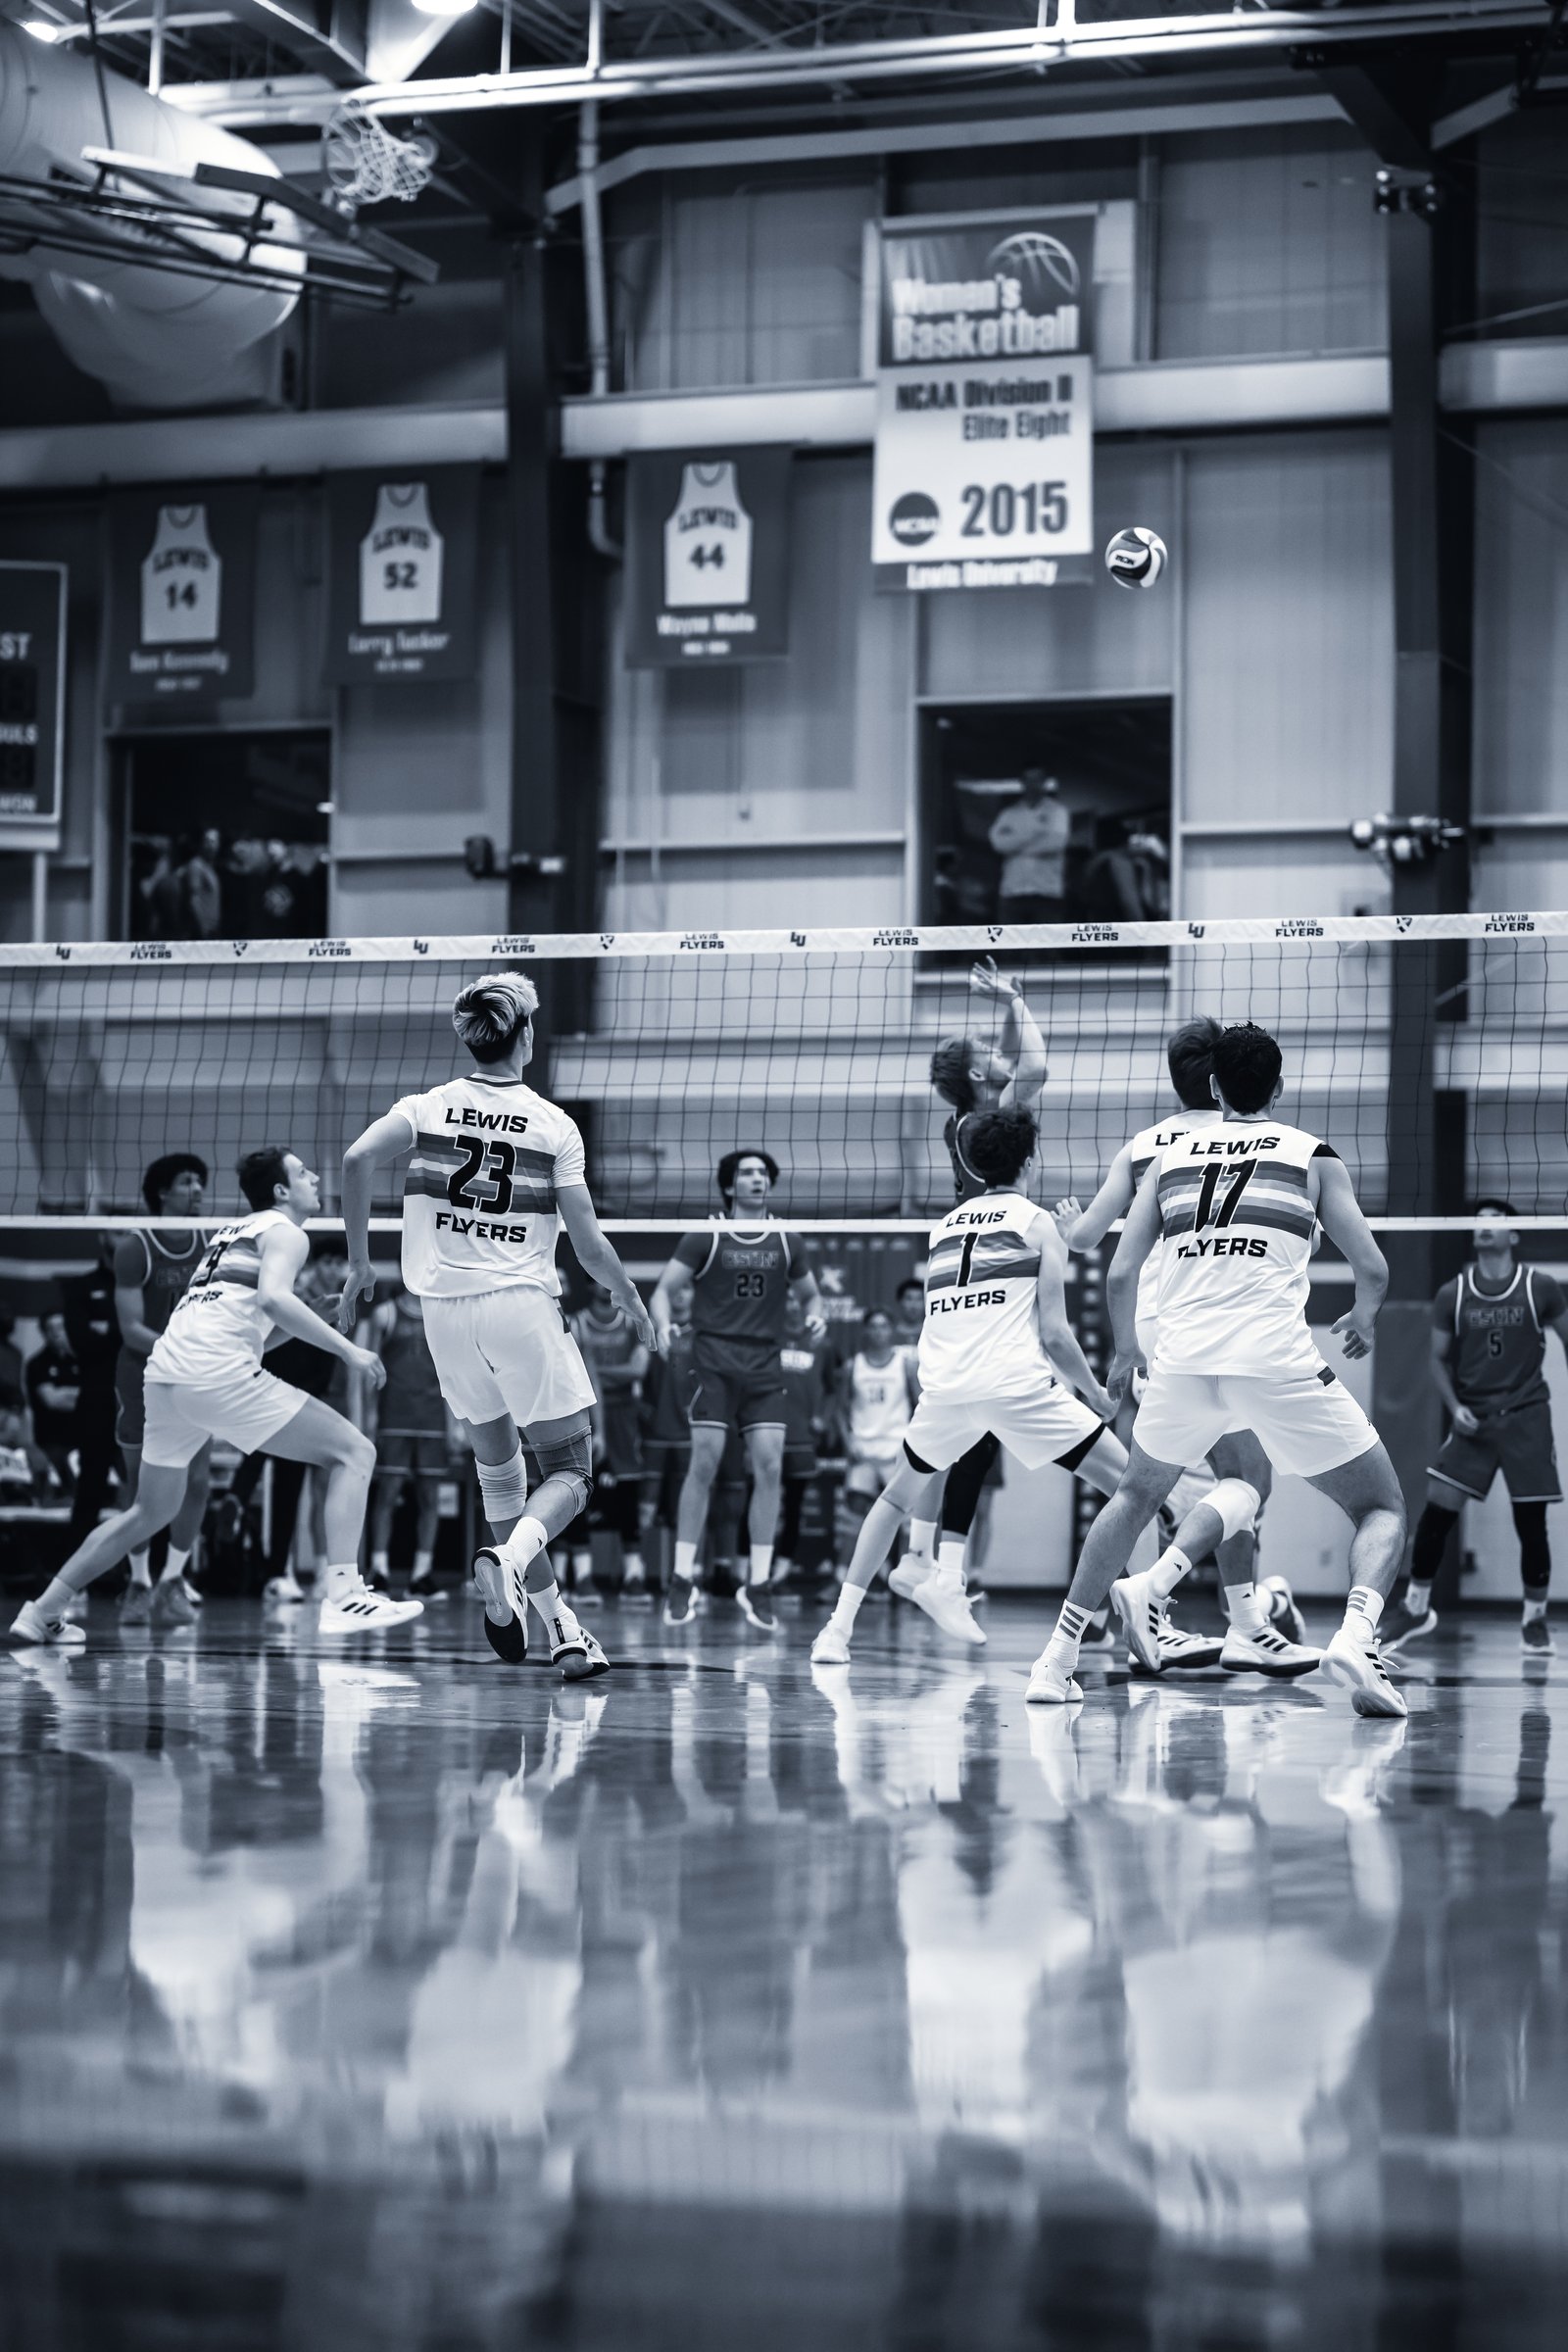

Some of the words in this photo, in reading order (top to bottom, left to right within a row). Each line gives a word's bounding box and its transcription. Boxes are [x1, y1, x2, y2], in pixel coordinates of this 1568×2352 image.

[894, 272, 1022, 316] Women's
[893, 304, 1078, 362] Basketball
[896, 380, 957, 411] NCAA
[963, 378, 1052, 408] Division
[963, 414, 1008, 440] Elite
[1015, 411, 1069, 441] Eight
[960, 480, 1068, 538] 2015
[689, 543, 724, 569] 44
[383, 562, 418, 590] 52
[906, 562, 960, 589] Lewis
[167, 581, 198, 611] 14
[1071, 932, 1119, 942] FLYERS
[1275, 927, 1324, 937] FLYERS
[1485, 922, 1536, 932] FLYERS
[309, 948, 351, 956] FLYERS
[492, 945, 535, 954] FLYERS
[679, 941, 724, 950] FLYERS
[873, 937, 918, 947] FLYERS
[445, 1107, 528, 1133] LEWIS
[1190, 1137, 1281, 1155] LEWIS
[447, 1134, 516, 1214] 23
[1195, 1158, 1258, 1233] 17
[435, 1212, 527, 1243] FLYERS
[946, 1210, 1007, 1228] LEWIS
[956, 1232, 979, 1288] 1
[1177, 1237, 1268, 1259] FLYERS
[735, 1272, 765, 1299] 23
[930, 1290, 1006, 1316] FLYERS
[1489, 1329, 1504, 1358] 5
